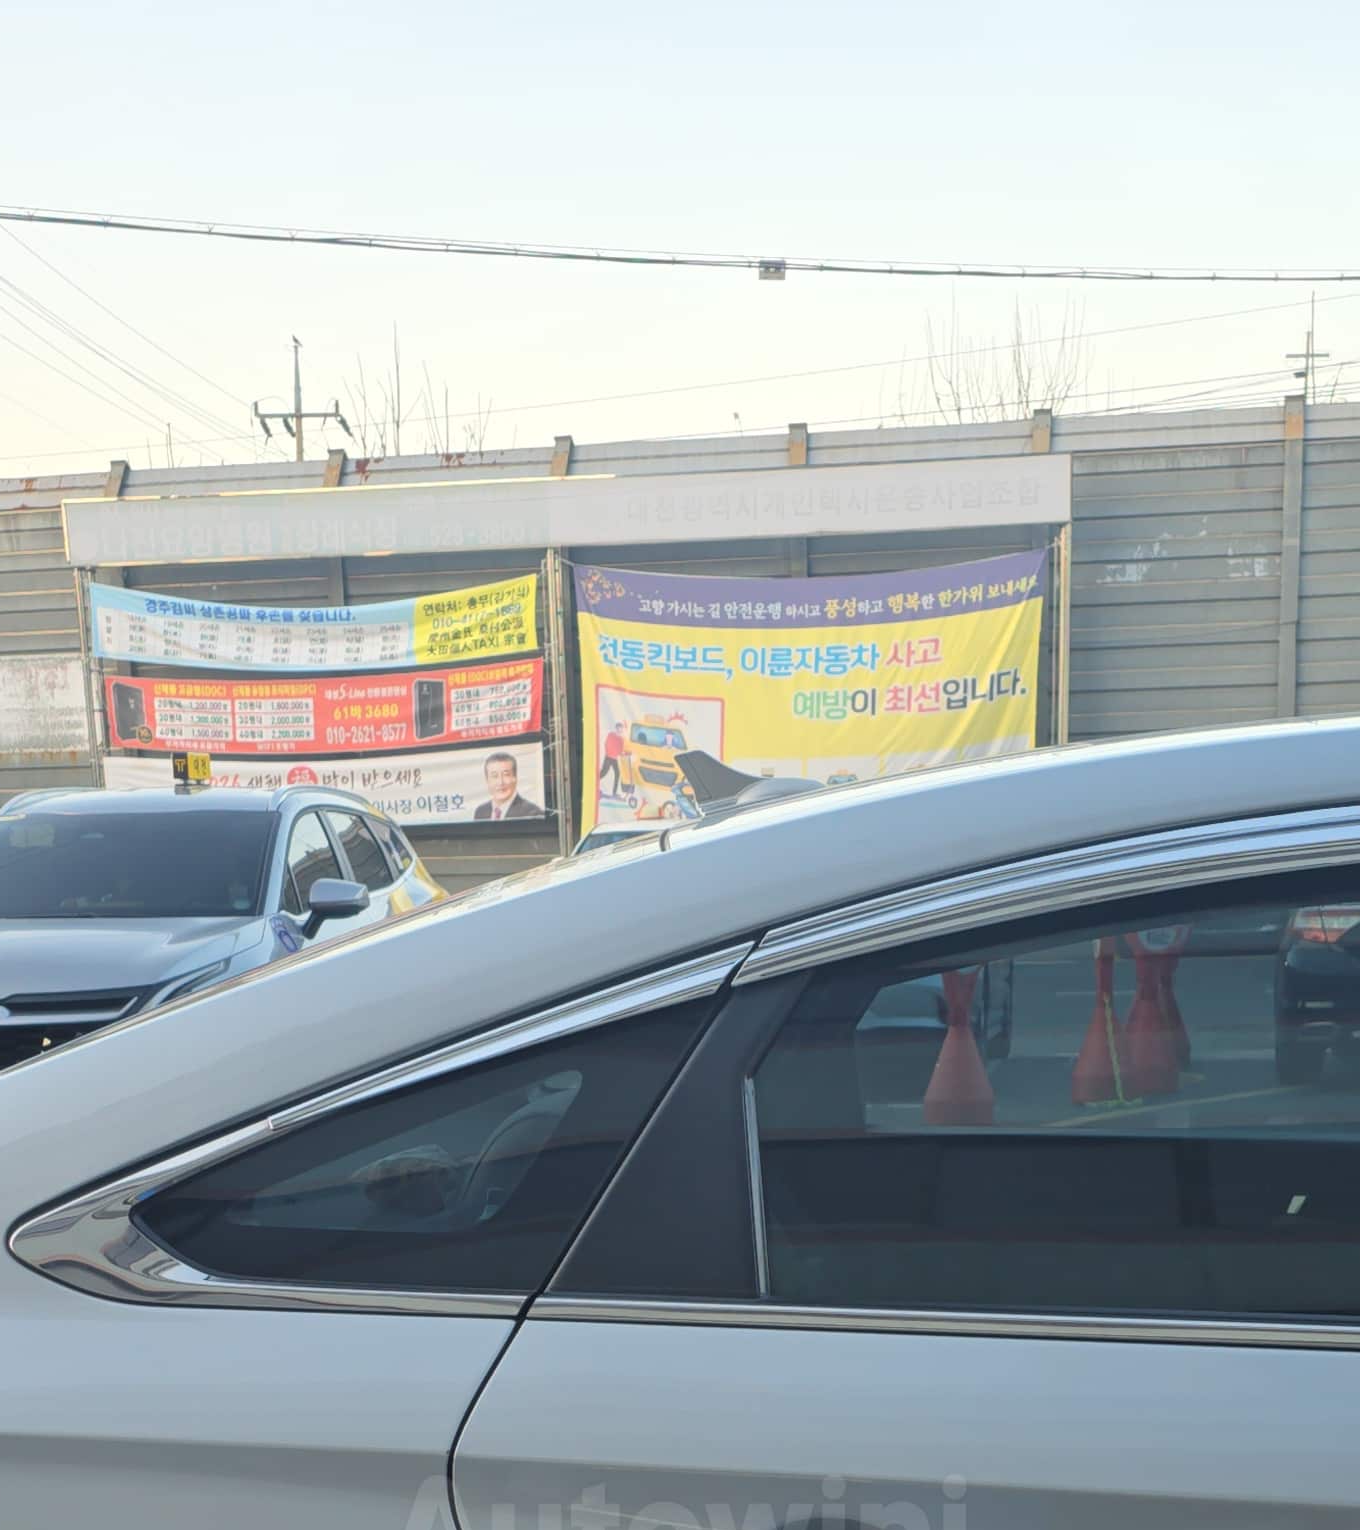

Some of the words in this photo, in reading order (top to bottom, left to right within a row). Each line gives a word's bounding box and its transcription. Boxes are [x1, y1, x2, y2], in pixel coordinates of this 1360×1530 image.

[639, 599, 663, 616] 고향
[667, 602, 705, 618] 가시는
[707, 603, 721, 619] 길
[724, 602, 782, 620] 안전운행
[824, 597, 884, 619] 풍성하고
[887, 592, 935, 614] 행복한
[938, 584, 983, 608] 한가위
[598, 634, 734, 681] 전동킥보드,
[740, 642, 881, 678] 이륜자동차
[885, 637, 943, 668] 사고
[793, 688, 877, 721] 예방이
[884, 668, 1027, 714] 최선입니다.
[365, 703, 399, 719] 3680
[325, 722, 408, 745] 010-2621-8577
[247, 774, 283, 789] 새해
[361, 767, 424, 790] 받으세요
[416, 793, 466, 813] 이철호
